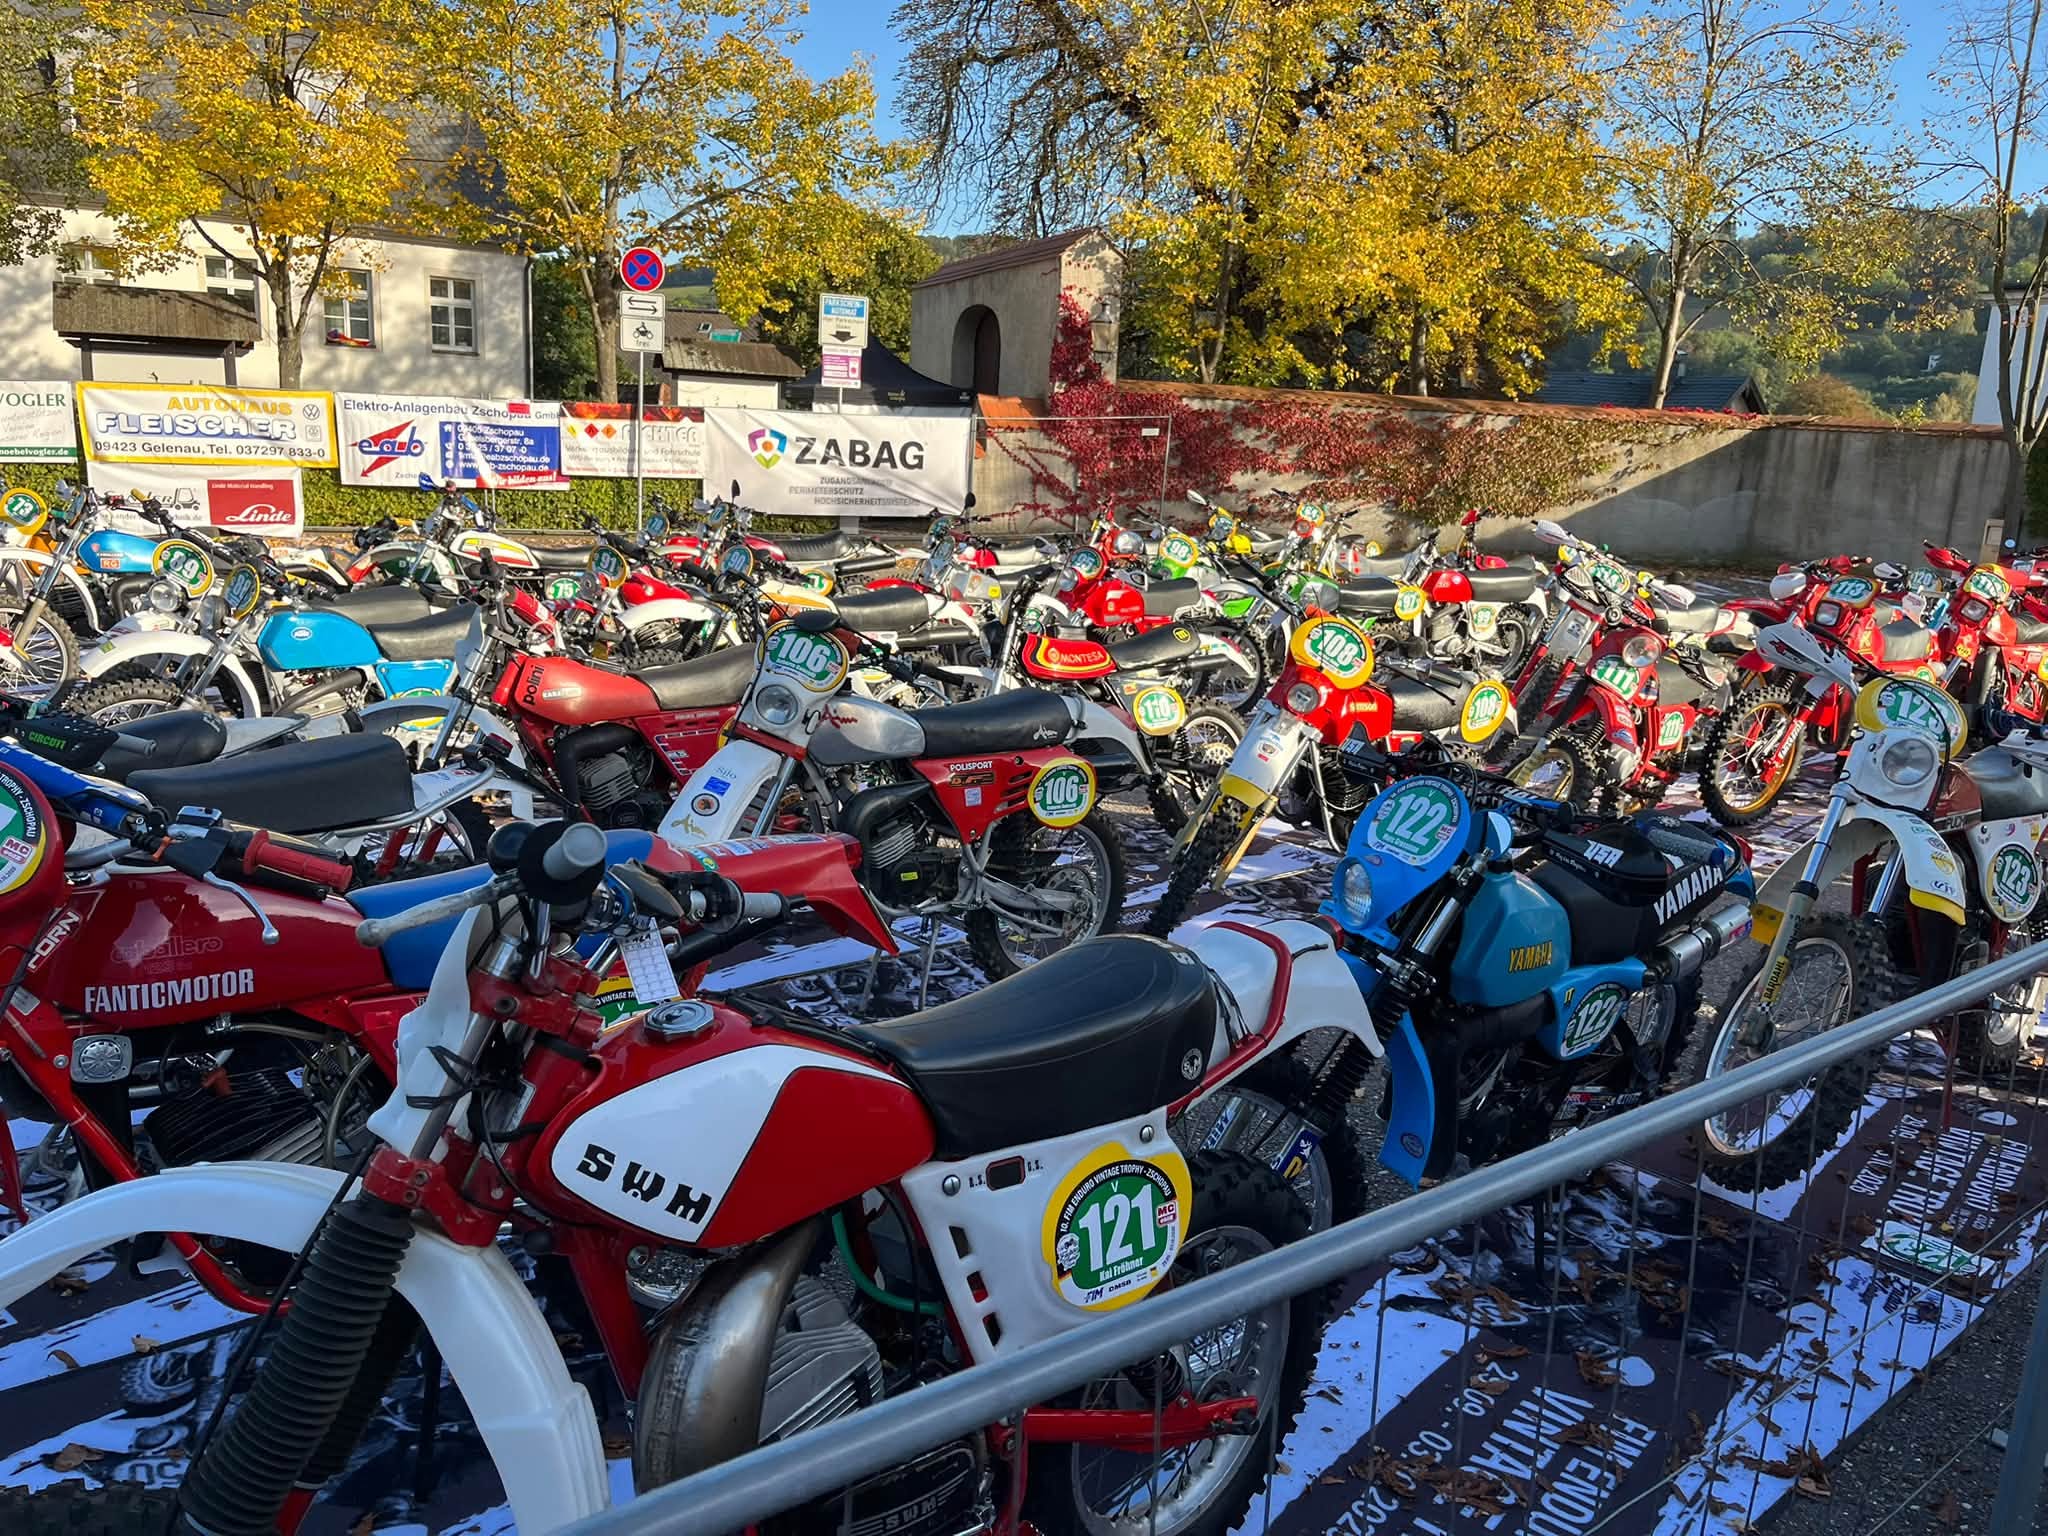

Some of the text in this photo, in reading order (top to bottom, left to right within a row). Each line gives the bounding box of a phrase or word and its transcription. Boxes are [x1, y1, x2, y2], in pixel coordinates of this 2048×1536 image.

[168, 397, 292, 415] AUTOHAUS
[343, 399, 467, 416] Elektro-Anlagenbau
[96, 411, 297, 440] FLEISCHER
[95, 440, 325, 458] 09423 Gelenau, Tel. 037297 833-0
[795, 437, 925, 470] ZABAG
[14, 498, 34, 516] 73
[225, 504, 293, 523] Linde
[169, 549, 201, 580] 89
[601, 555, 618, 571] 91
[557, 582, 574, 597] 75
[778, 633, 831, 673] 106
[1059, 651, 1105, 664] MONTESA
[1317, 630, 1359, 666] 108
[523, 664, 545, 706] polini
[1475, 696, 1496, 720] 108
[28, 730, 67, 750] CIRCUIT
[950, 760, 993, 771] POLISPORT
[1044, 775, 1079, 804] 106
[0, 773, 23, 796] TROPHY
[20, 797, 37, 838] ZSCHOPAU
[1386, 794, 1447, 846] 122
[5, 838, 30, 855] MC
[2002, 856, 2030, 897] 123
[1653, 864, 1724, 926] YAMAHA
[1508, 940, 1554, 974] YAMAHA
[84, 968, 255, 1014] FANTICMOTOR
[1764, 960, 1785, 999] BARDAHL
[1574, 995, 1618, 1039] 122
[576, 1143, 713, 1225] SWM
[1065, 1205, 1075, 1222] FIM
[1072, 1180, 1095, 1206] ENDURO
[1093, 1166, 1120, 1184] VINTAGE
[1120, 1164, 1144, 1175] TROPHY
[1146, 1167, 1171, 1197] ZSCHOPAU
[1111, 1181, 1119, 1193] V
[1157, 1203, 1175, 1217] MC
[1078, 1184, 1156, 1272] 121
